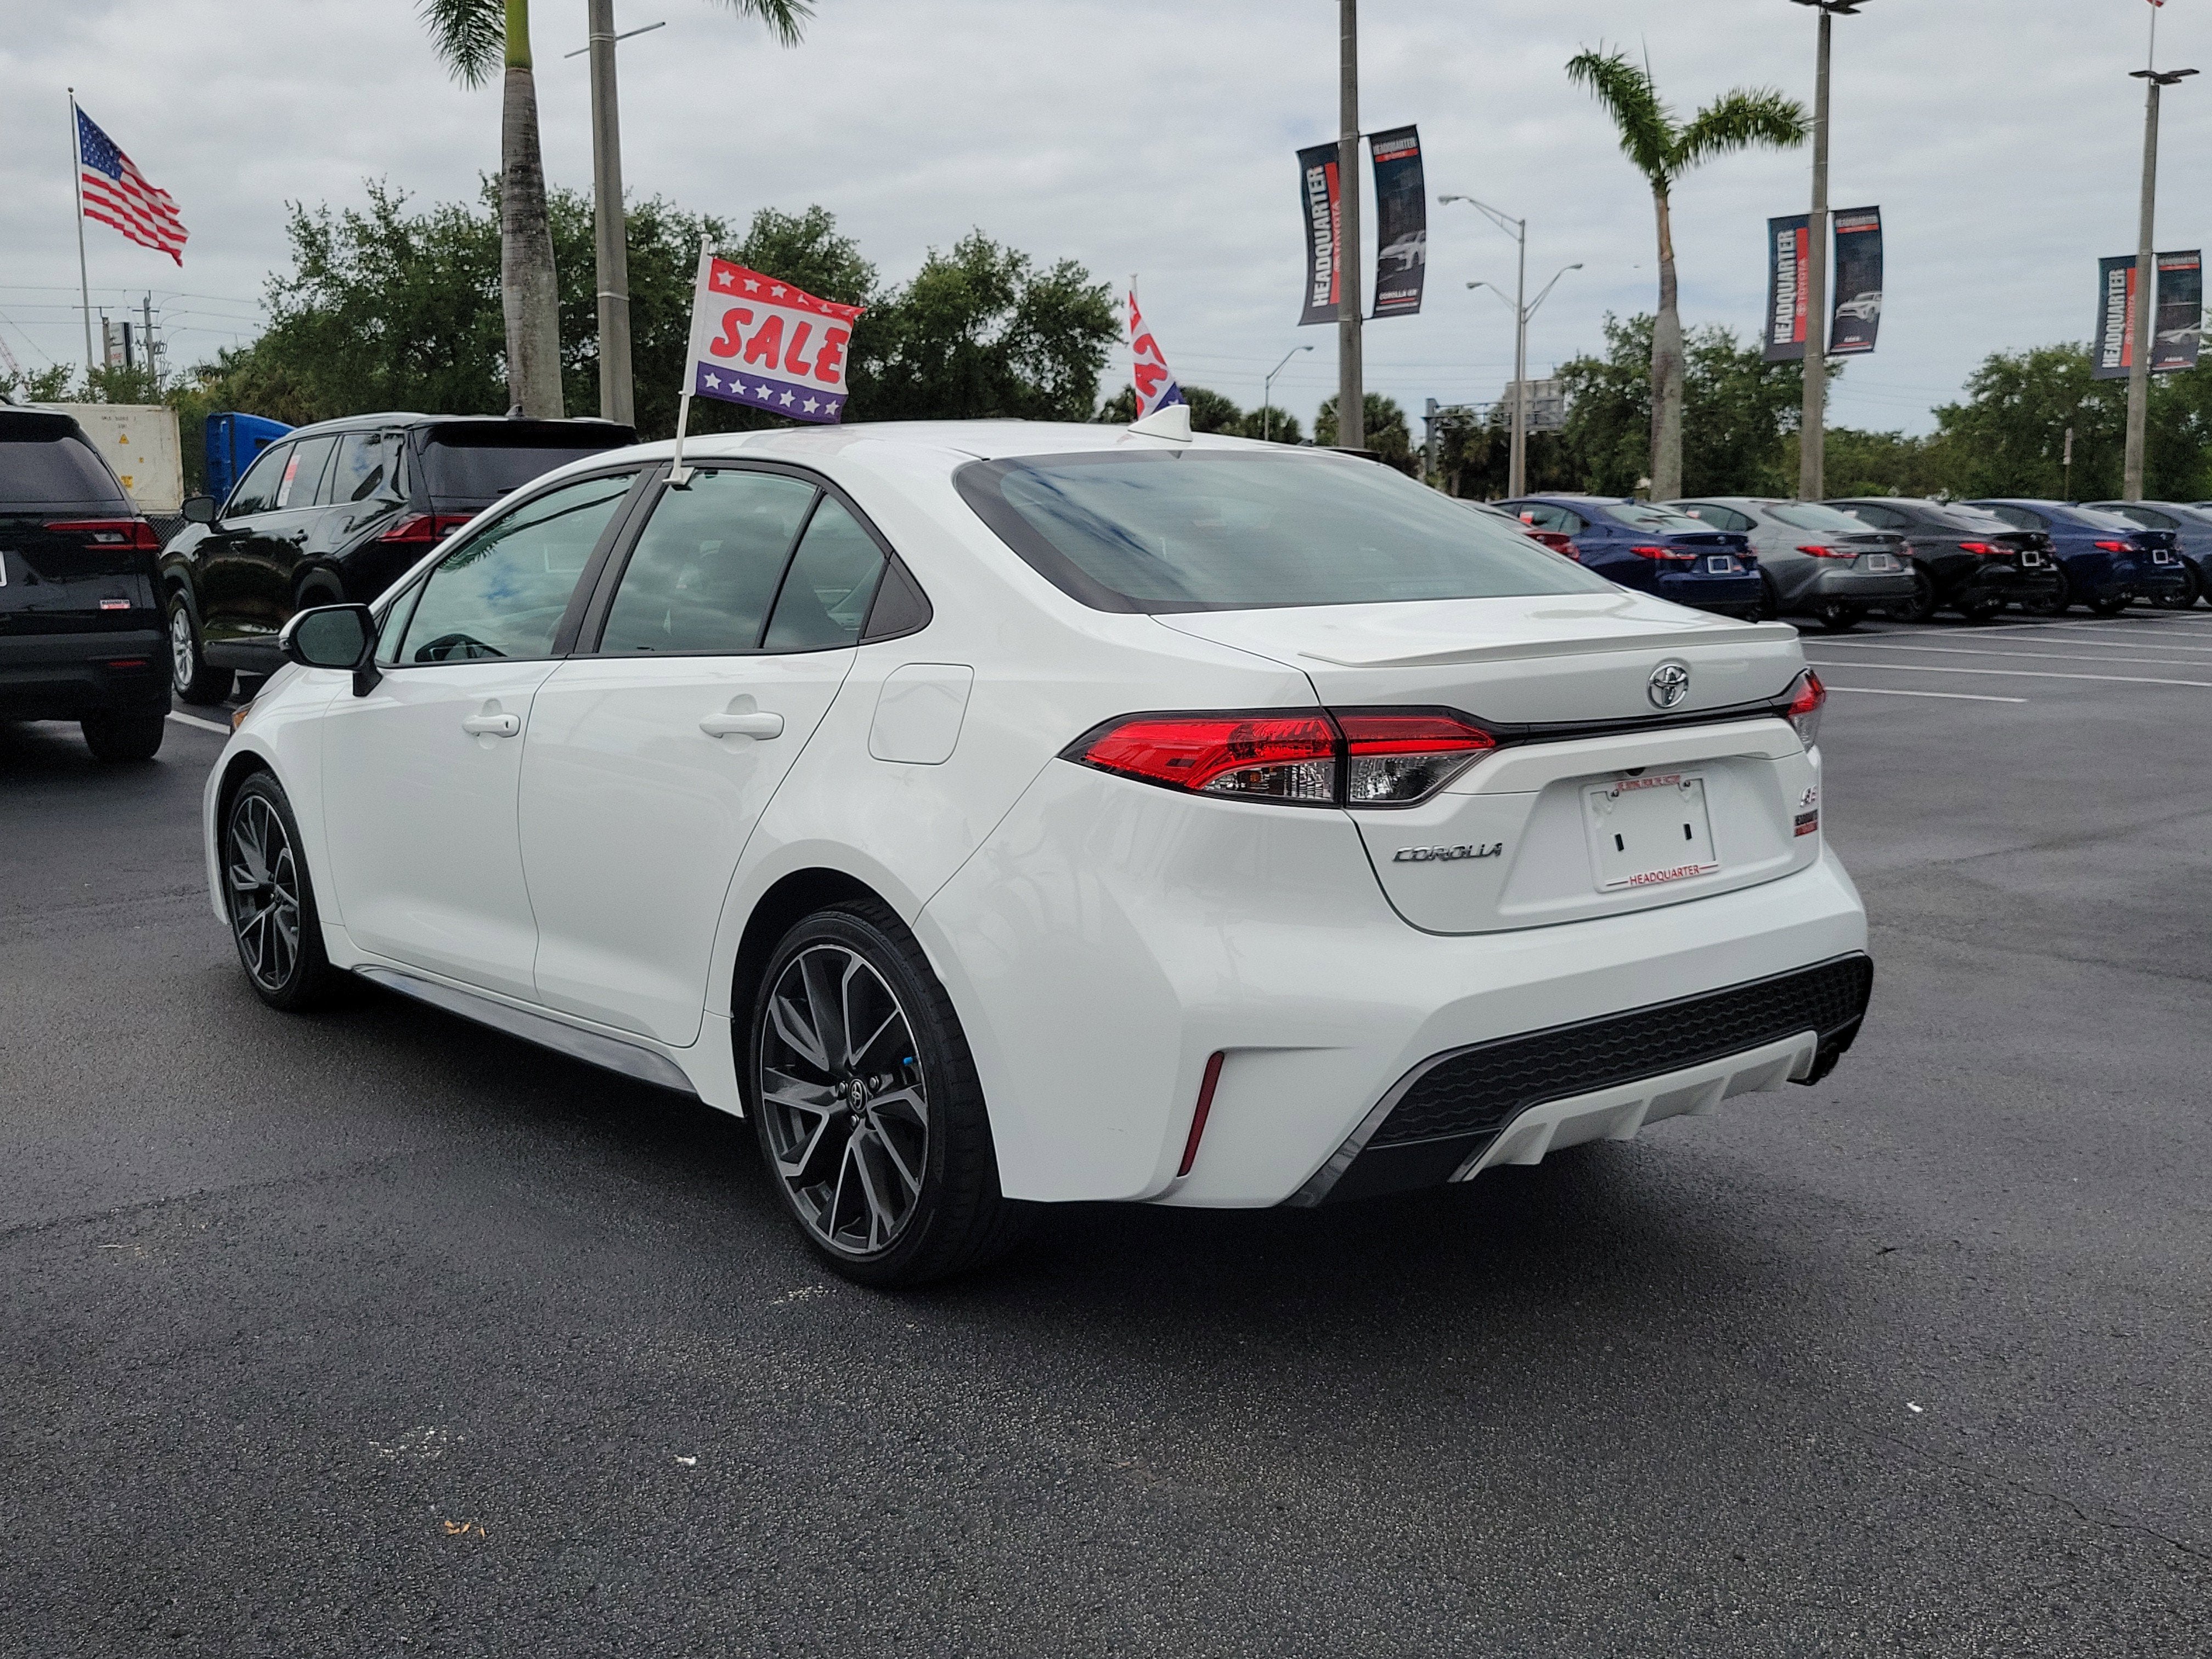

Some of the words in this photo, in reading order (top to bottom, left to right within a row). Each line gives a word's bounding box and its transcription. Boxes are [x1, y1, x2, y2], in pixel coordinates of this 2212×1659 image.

[1306, 165, 1333, 307] HEADQUARTER
[1774, 229, 1796, 344] HEADQUARTER
[2102, 269, 2125, 368] HEADQUARTER
[710, 308, 850, 384] SALE
[1392, 842, 1503, 862] COROLLA
[1629, 865, 1700, 885] HEADQUARTER
